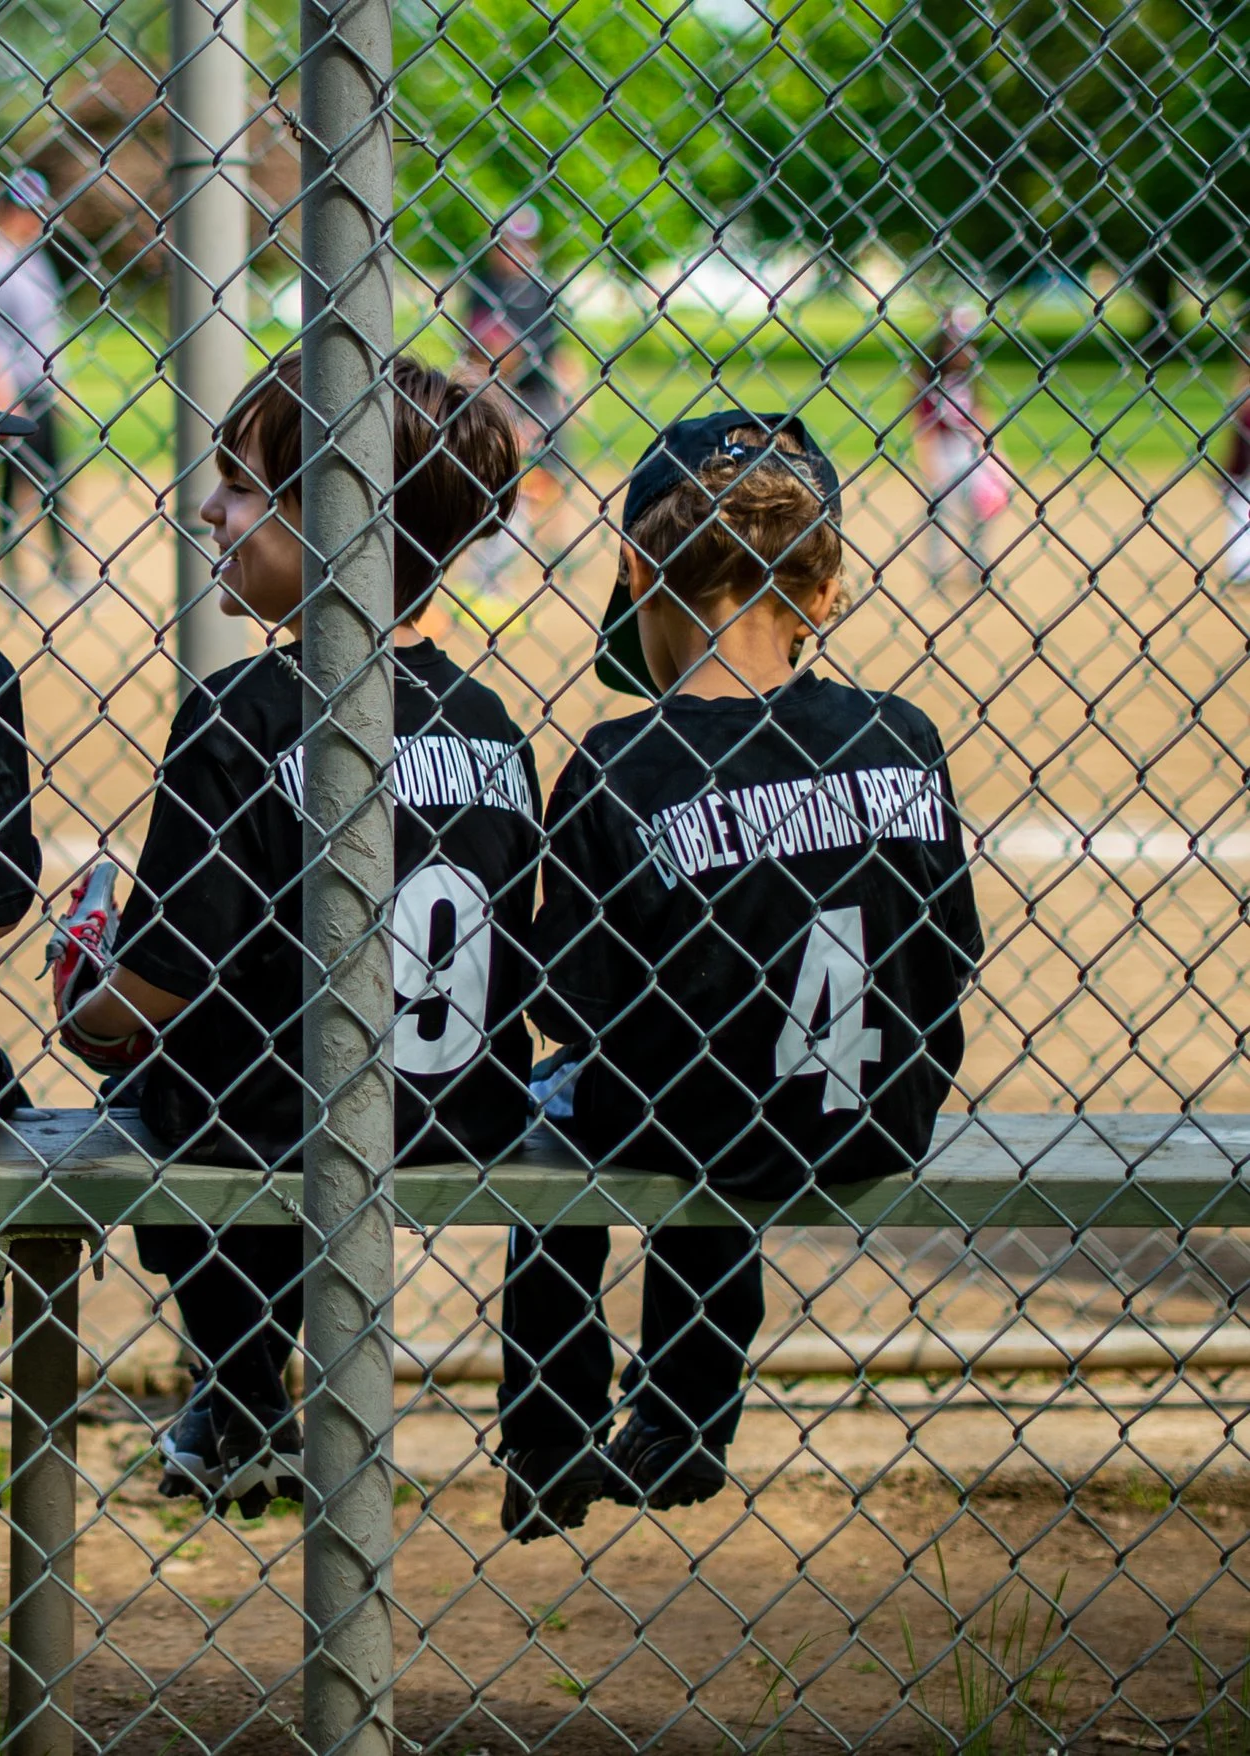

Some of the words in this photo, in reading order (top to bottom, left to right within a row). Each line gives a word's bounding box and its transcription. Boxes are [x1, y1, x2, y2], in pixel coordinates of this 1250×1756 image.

[394, 735, 478, 807] OUNTAIN
[636, 793, 739, 890] DOUBLE
[729, 773, 861, 863] MOUNTAIN
[393, 864, 491, 1074] 9
[775, 906, 882, 1114] 4
